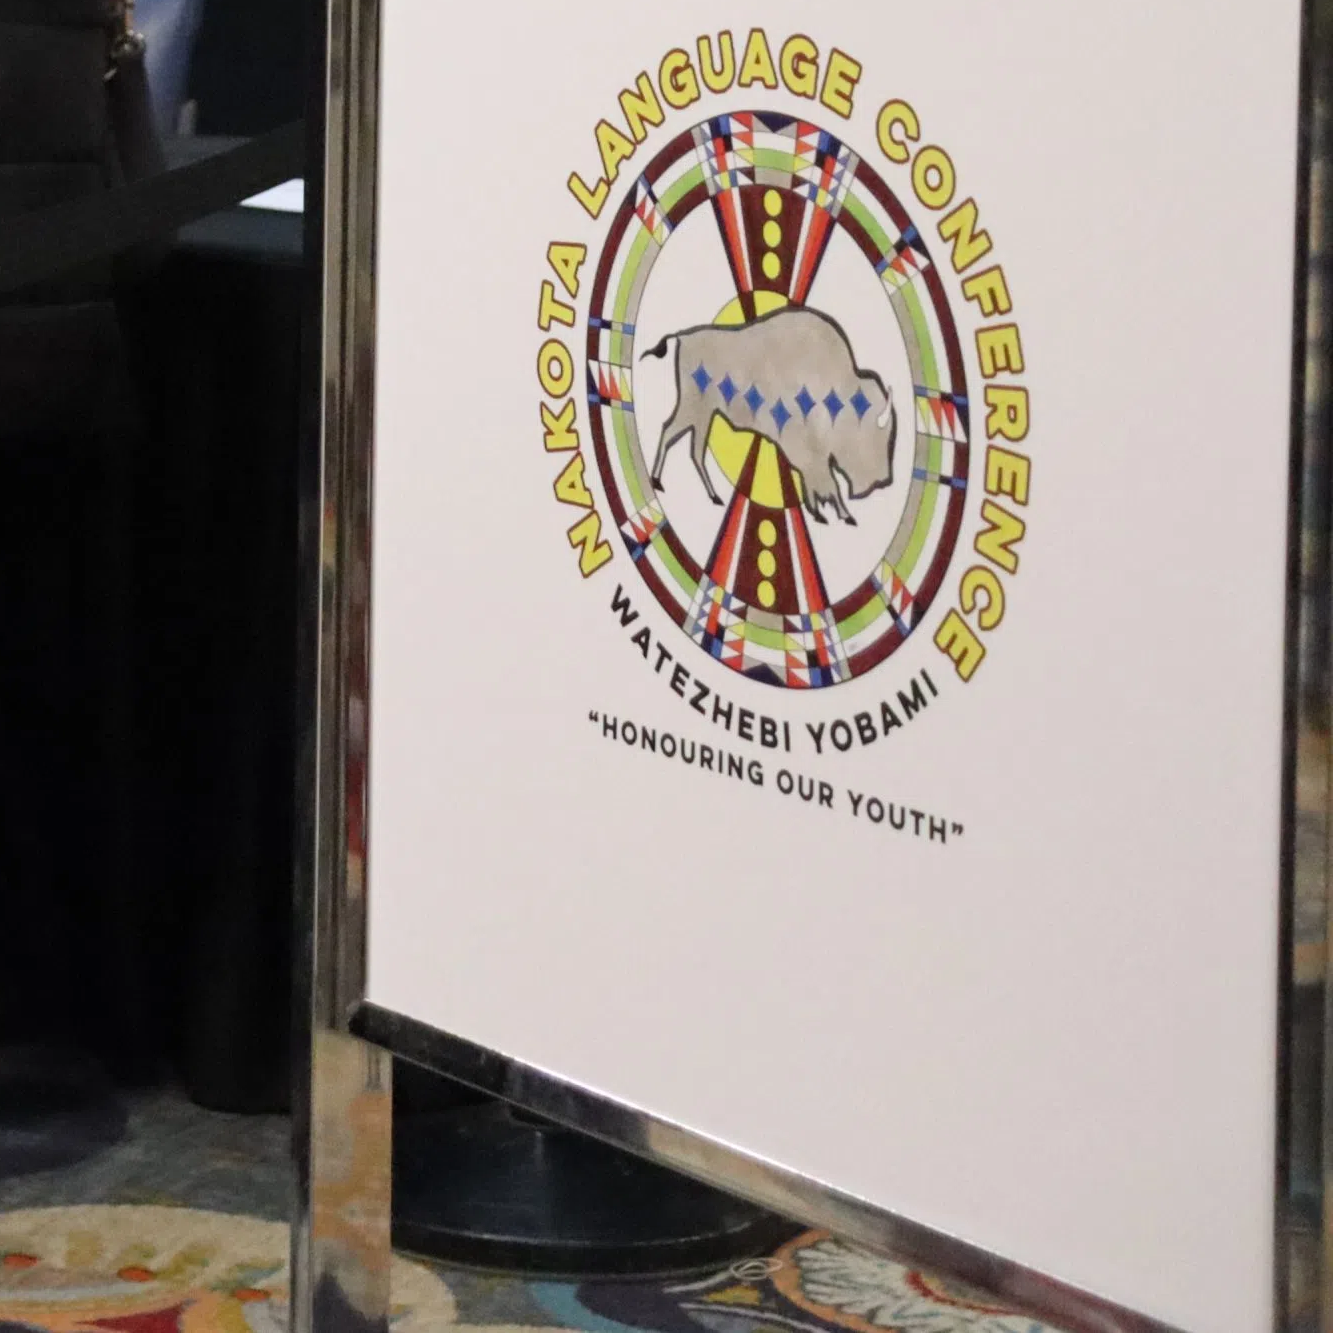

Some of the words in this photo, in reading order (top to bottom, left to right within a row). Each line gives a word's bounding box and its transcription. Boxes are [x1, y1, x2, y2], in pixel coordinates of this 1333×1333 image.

[567, 28, 862, 220] LANGUAGE
[537, 241, 614, 579] NAKOTA
[876, 99, 1031, 683] CONFERENCE
[609, 583, 791, 753] WATEZHEBI
[805, 668, 939, 754] YOBAMI
[776, 769, 834, 809] OUR
